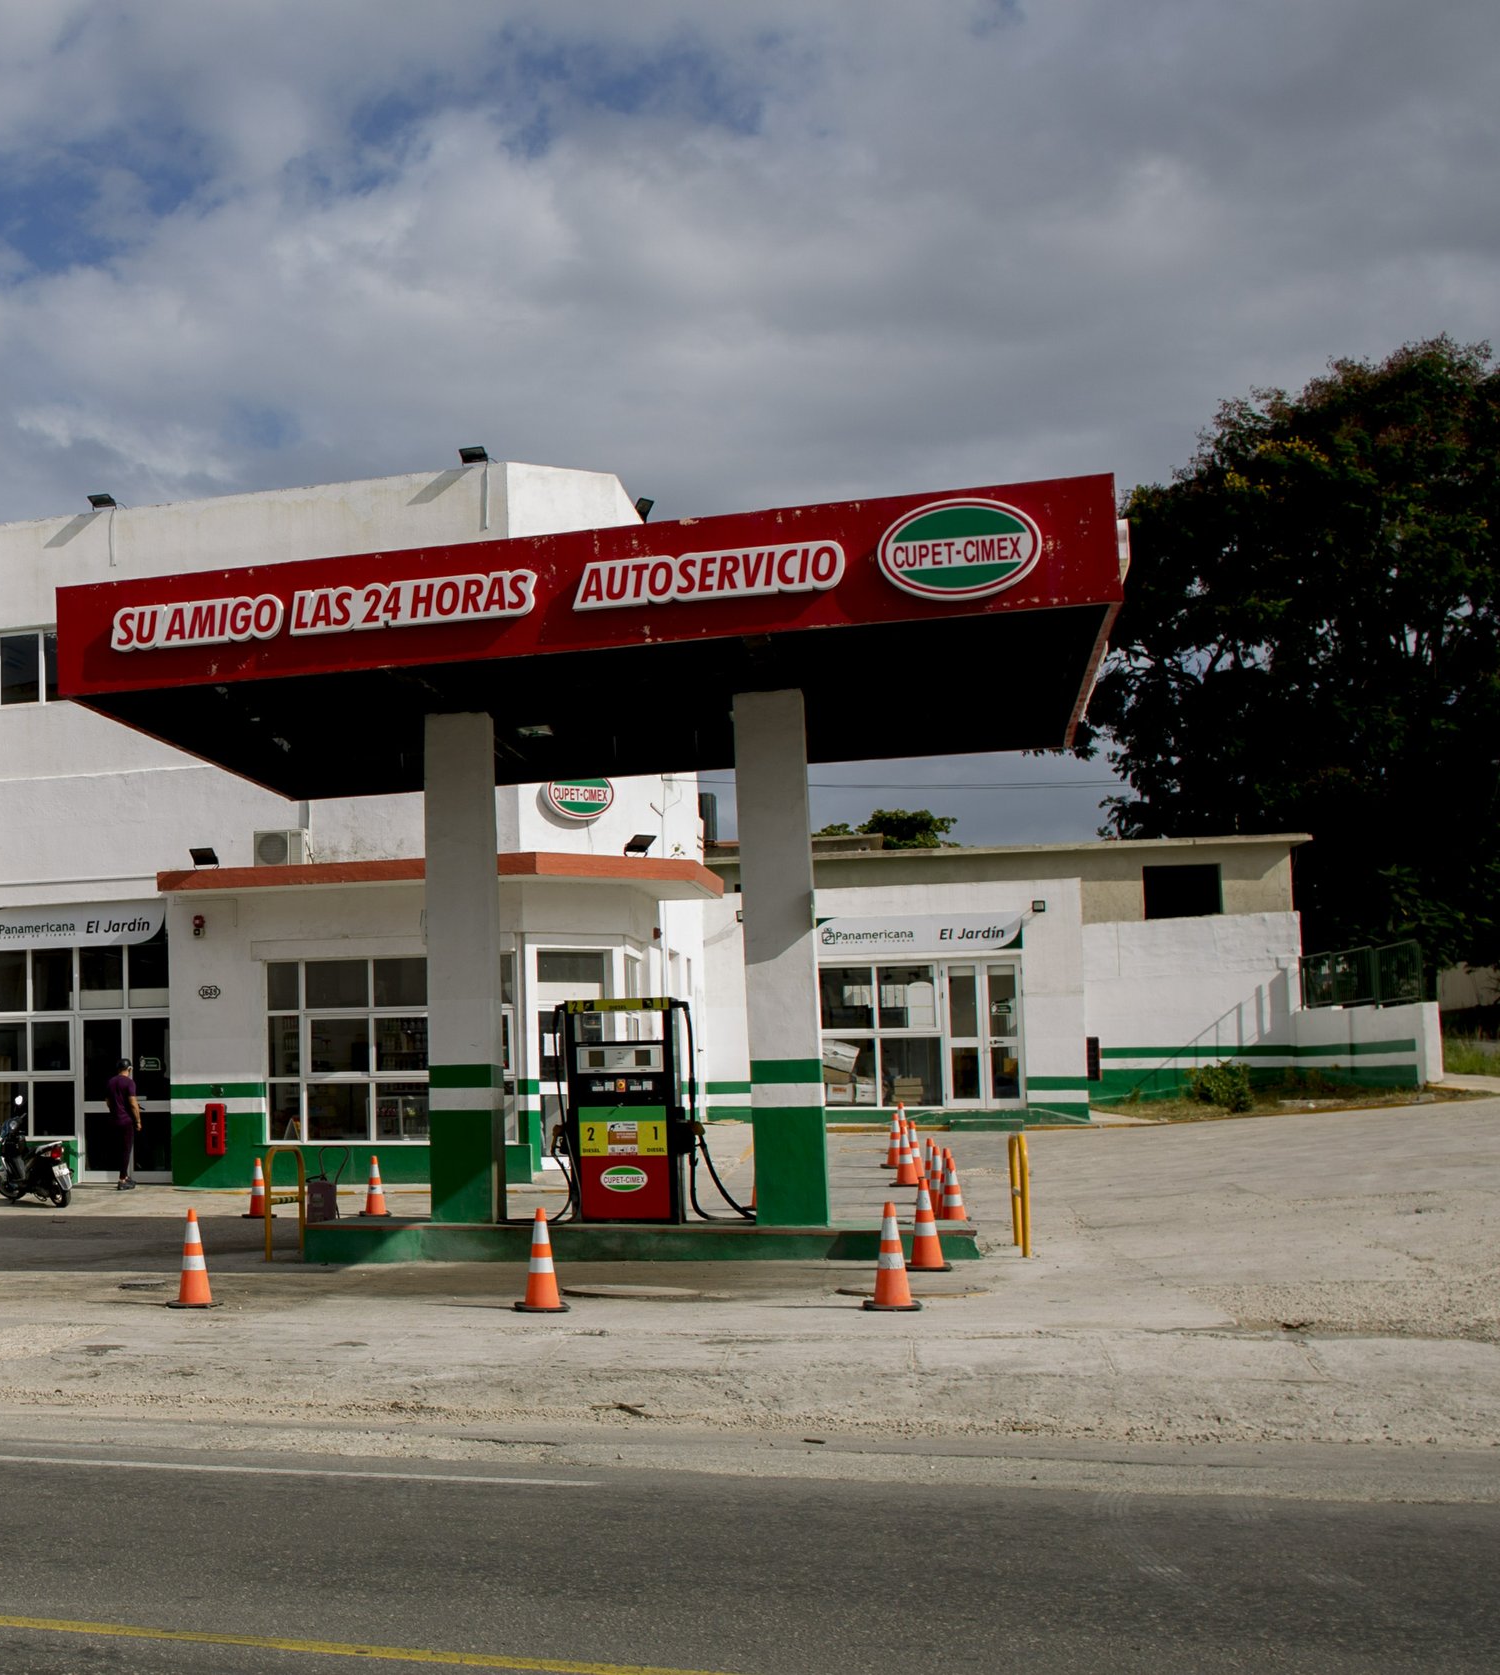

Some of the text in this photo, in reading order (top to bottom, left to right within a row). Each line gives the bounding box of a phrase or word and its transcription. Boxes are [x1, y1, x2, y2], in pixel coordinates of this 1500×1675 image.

[892, 535, 1023, 569] CUPET-CIMEX
[580, 544, 839, 604] AUTOSERVICIO
[114, 573, 530, 648] SU AMIGO LAS 24 HORAS
[553, 787, 608, 802] CUPET-CIMEX
[0, 922, 75, 935] Panamericana
[86, 917, 150, 934] El Jardín
[835, 929, 914, 941] Panamericana
[939, 926, 1005, 940] El Jardín
[572, 1001, 578, 1012] 2
[587, 1127, 595, 1141] 2
[652, 1126, 658, 1141] 1
[603, 1176, 645, 1184] CUPET-CIMEX
